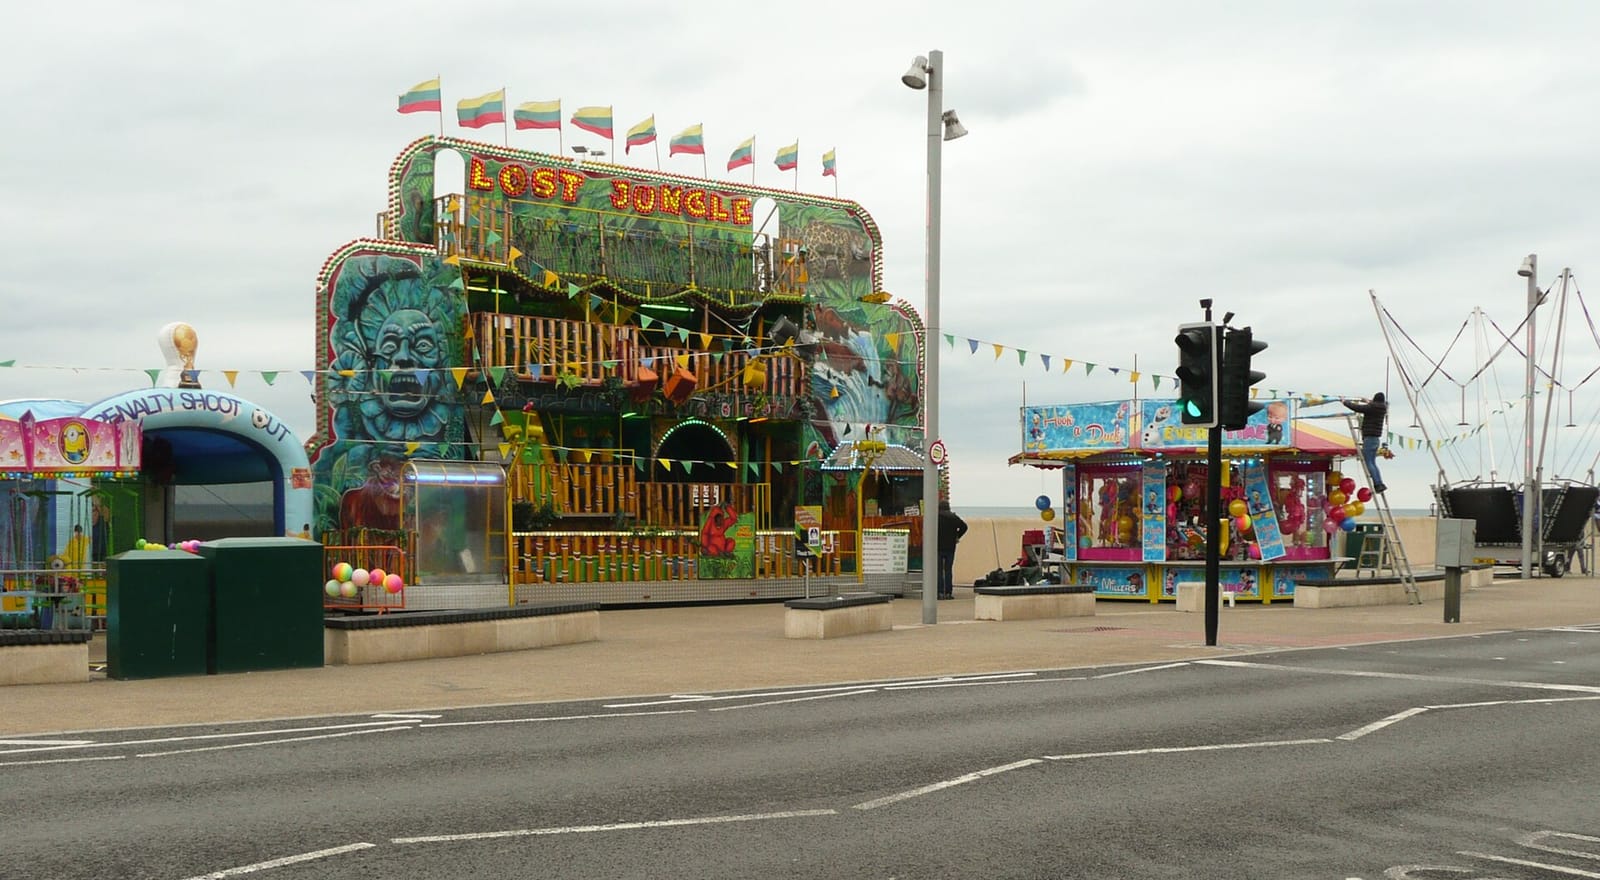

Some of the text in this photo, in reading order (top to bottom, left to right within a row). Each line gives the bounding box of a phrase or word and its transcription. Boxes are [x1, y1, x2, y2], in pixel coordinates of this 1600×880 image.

[468, 156, 753, 226] LOST JUNGLE
[180, 392, 242, 417] SHOOT
[1163, 425, 1209, 441] EVER
